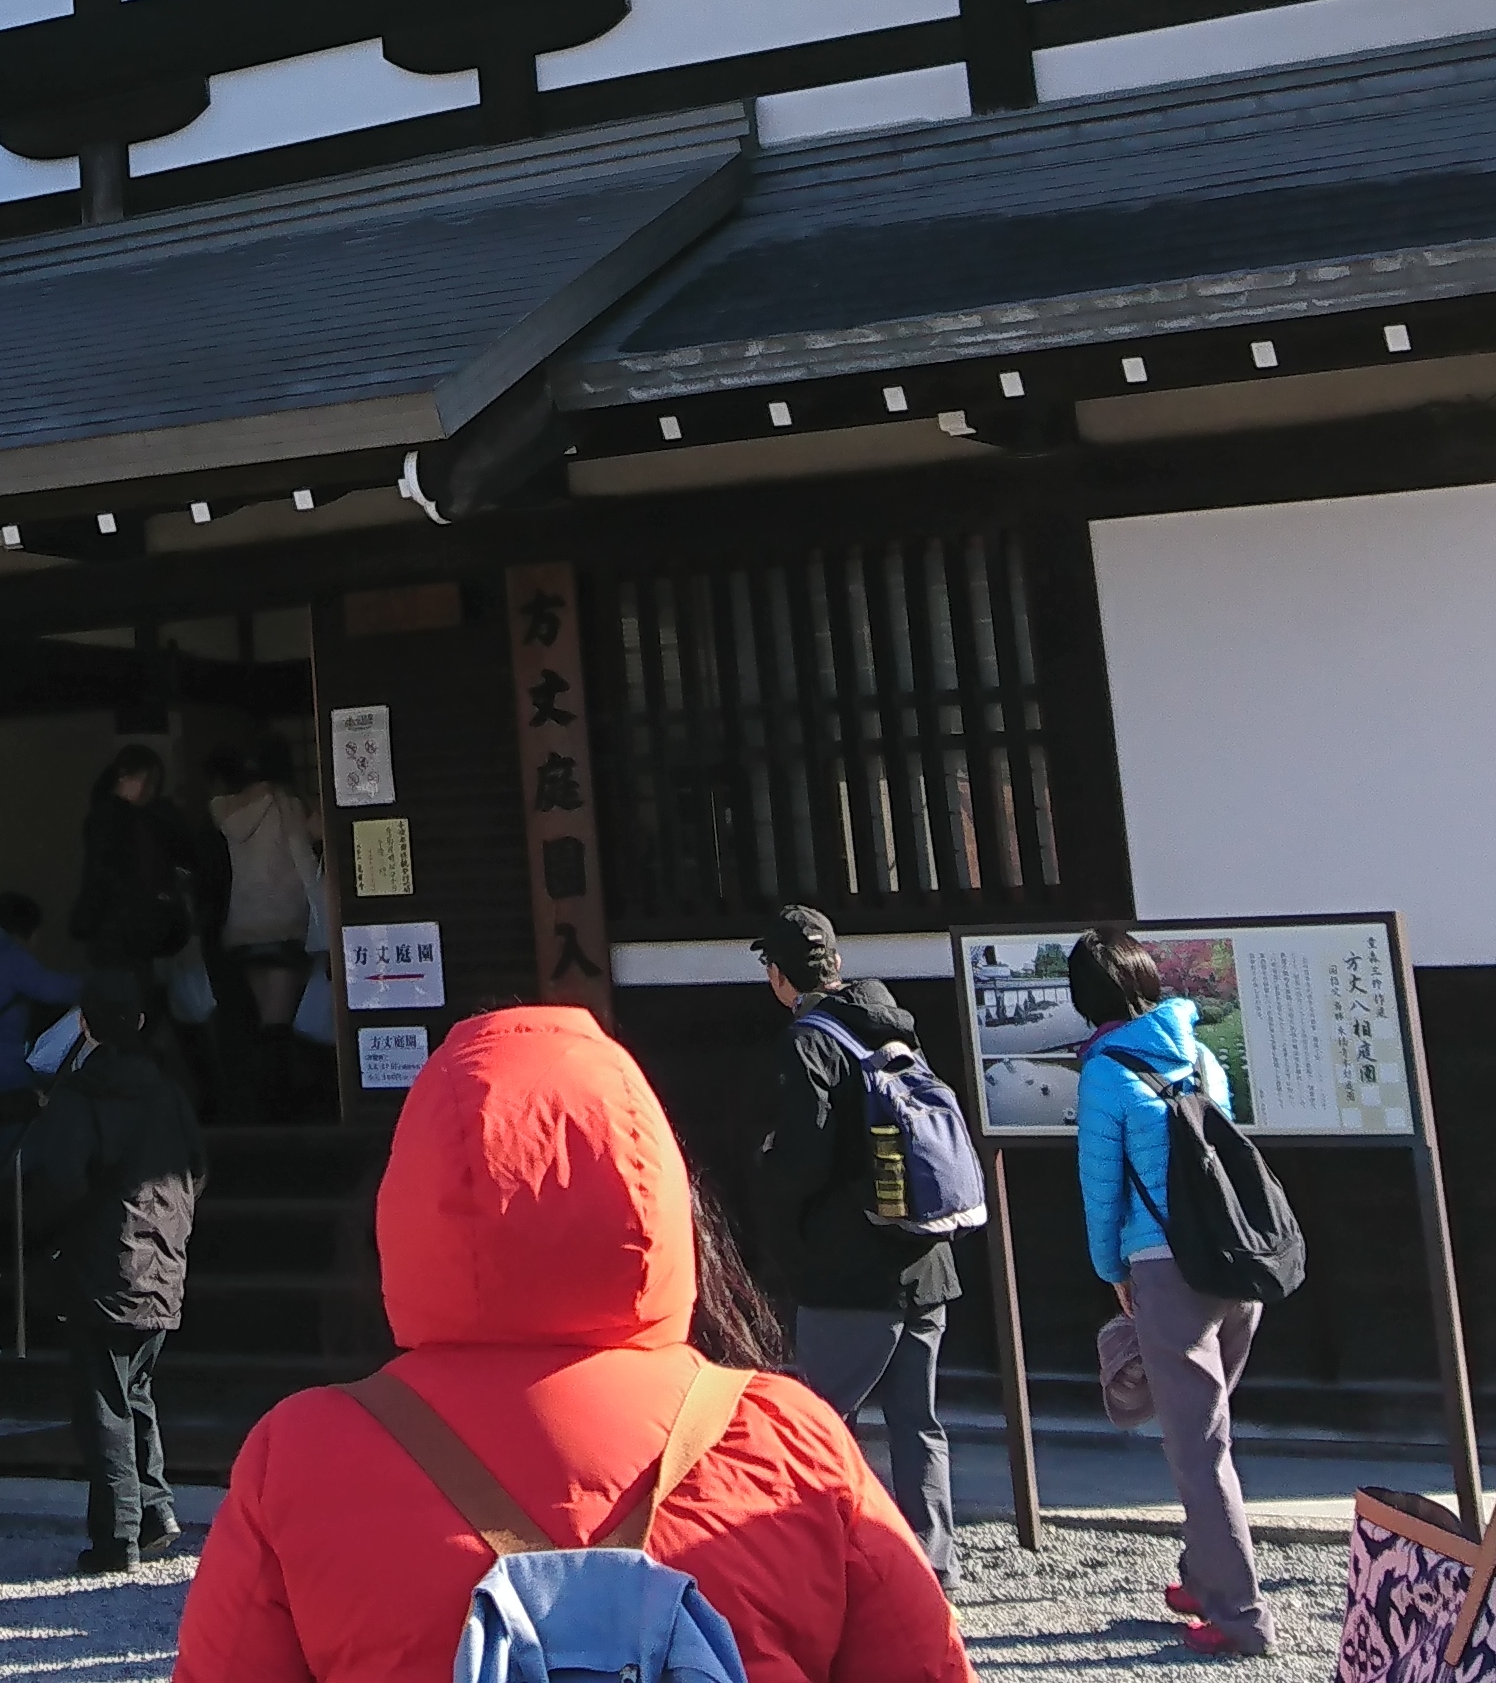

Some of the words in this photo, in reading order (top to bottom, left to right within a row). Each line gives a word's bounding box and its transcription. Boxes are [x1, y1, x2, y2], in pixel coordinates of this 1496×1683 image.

[353, 943, 435, 965] 方丈庭園
[1343, 951, 1378, 1084] 方丈八相庭園
[370, 1034, 417, 1050] 方丈庭園
